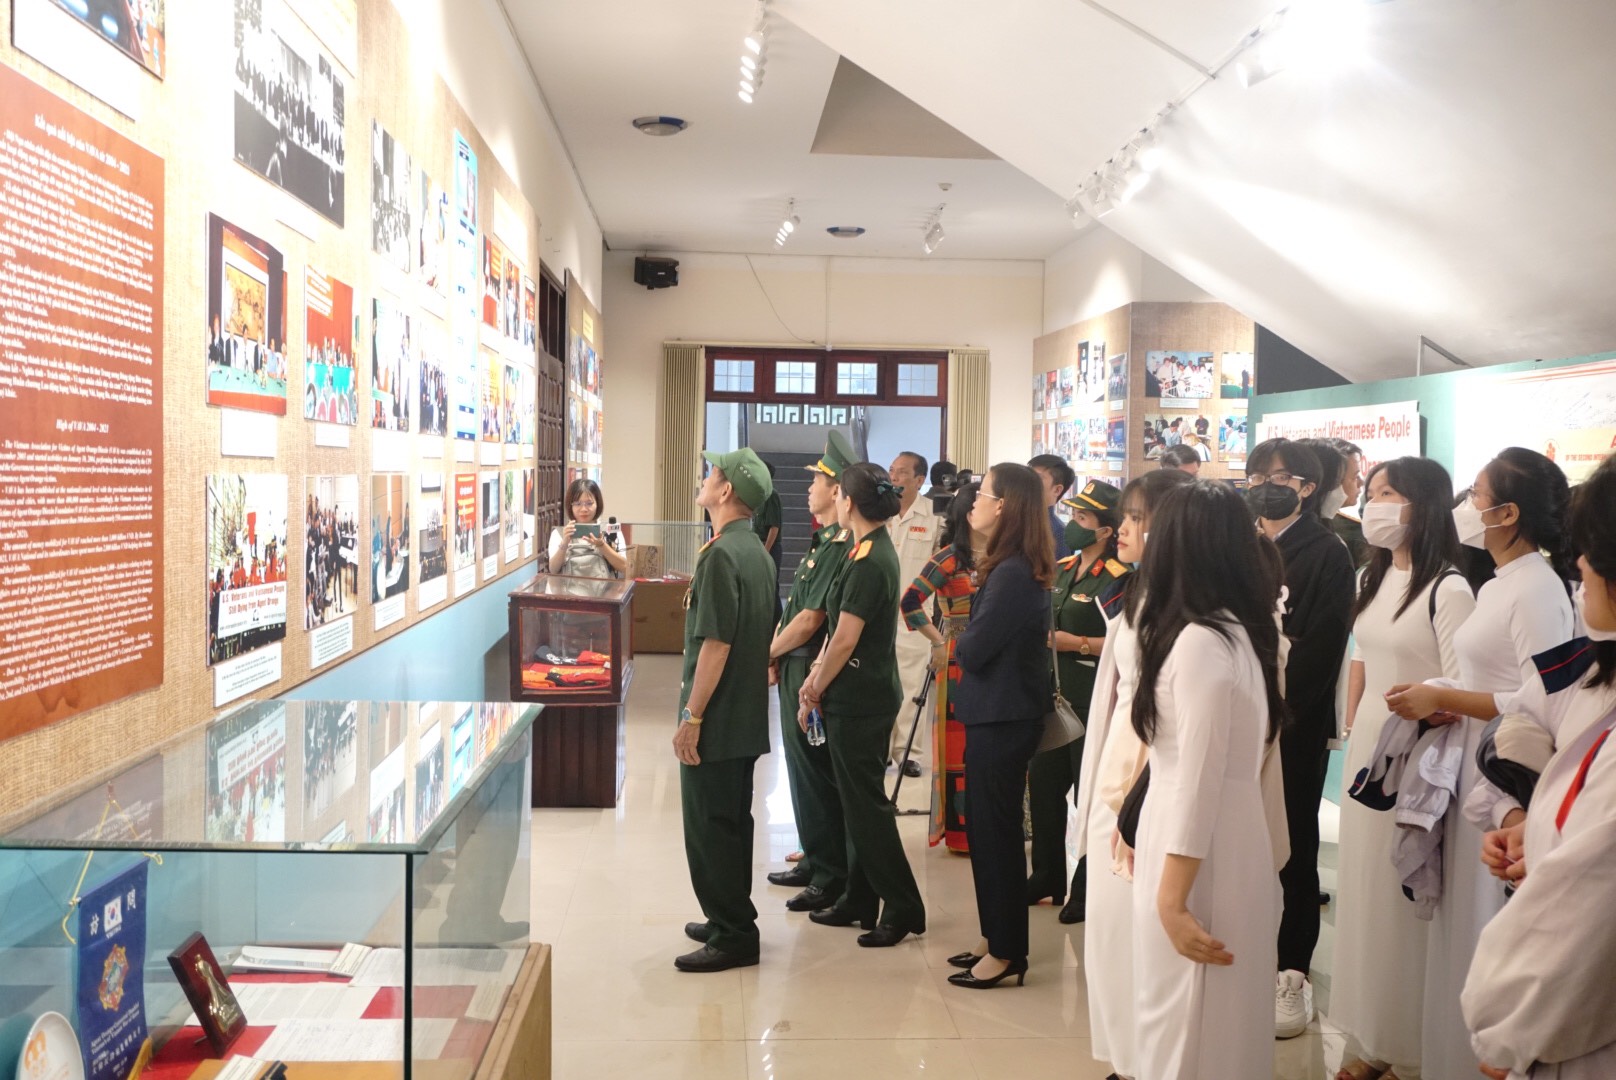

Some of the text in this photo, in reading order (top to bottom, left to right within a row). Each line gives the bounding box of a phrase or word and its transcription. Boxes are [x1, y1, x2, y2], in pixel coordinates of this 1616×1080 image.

[1313, 422, 1326, 439] and
[1328, 420, 1375, 440] Vietnamese
[1378, 414, 1410, 442] People
